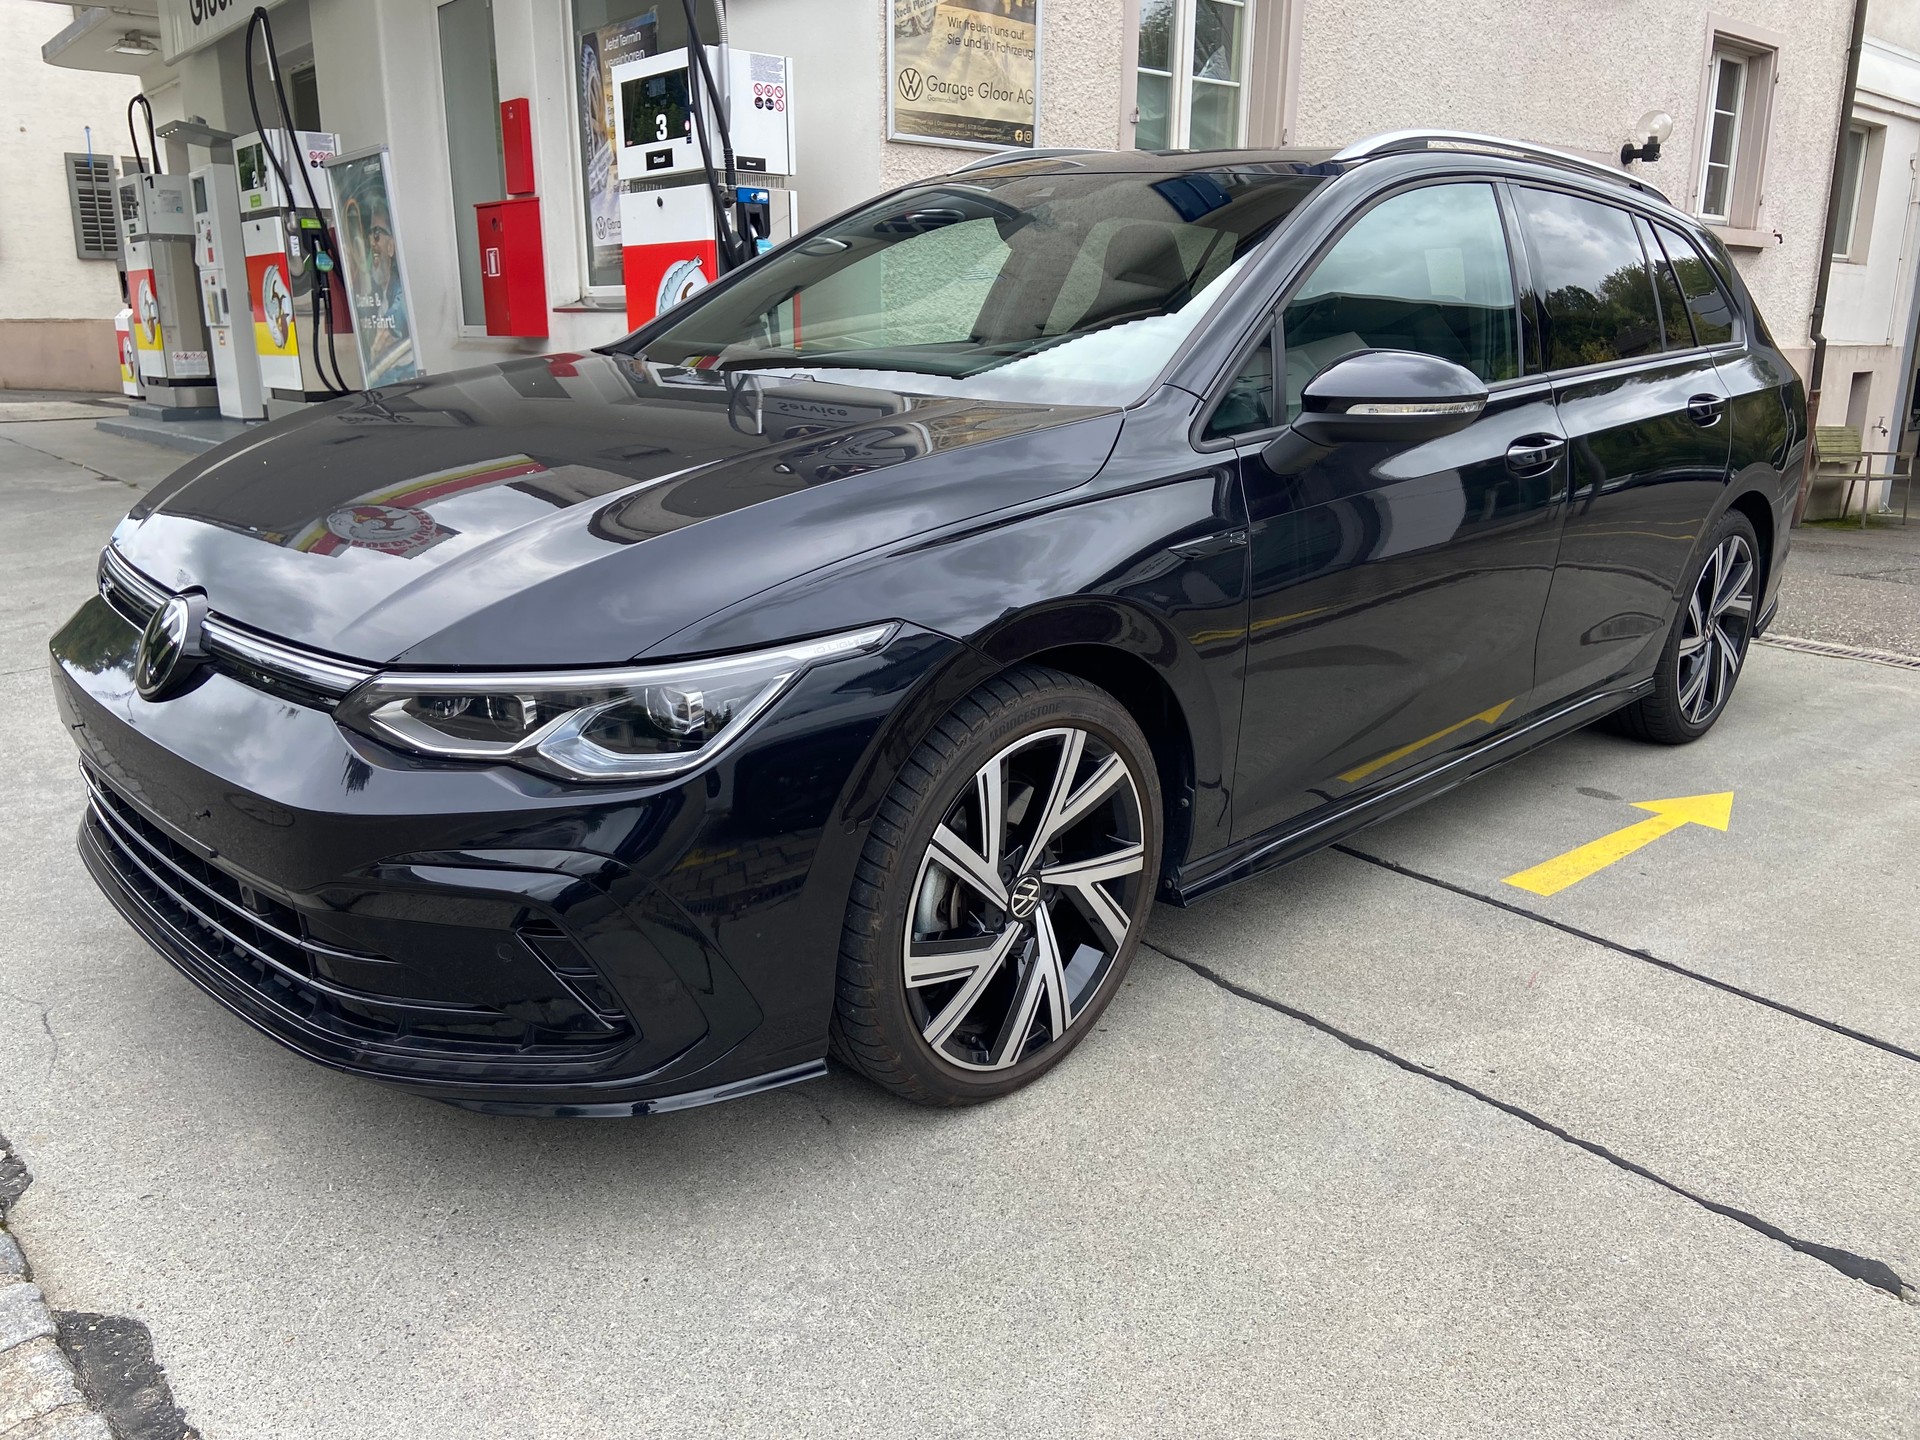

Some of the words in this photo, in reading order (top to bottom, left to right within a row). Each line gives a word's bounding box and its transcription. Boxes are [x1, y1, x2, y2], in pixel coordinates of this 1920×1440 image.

[190, 0, 232, 26] Glo
[948, 16, 962, 28] Wir
[964, 19, 992, 33] freuen
[995, 26, 1009, 37] uns
[1010, 30, 1025, 40] auf
[604, 35, 619, 52] Jetzt
[620, 29, 642, 46] Termin
[947, 34, 961, 46] Sie
[964, 37, 982, 49] und
[983, 39, 995, 51] Ihr
[604, 49, 646, 69] vereinbaren
[926, 75, 974, 100] Garage
[978, 82, 1014, 102] Gloor
[1016, 88, 1034, 105] AG
[655, 113, 669, 141] 3
[144, 175, 154, 189] 1
[252, 170, 259, 188] 2
[606, 218, 622, 230] Gara
[371, 314, 396, 329] Fahrt!
[989, 703, 1062, 742] BRIDGESTONE
